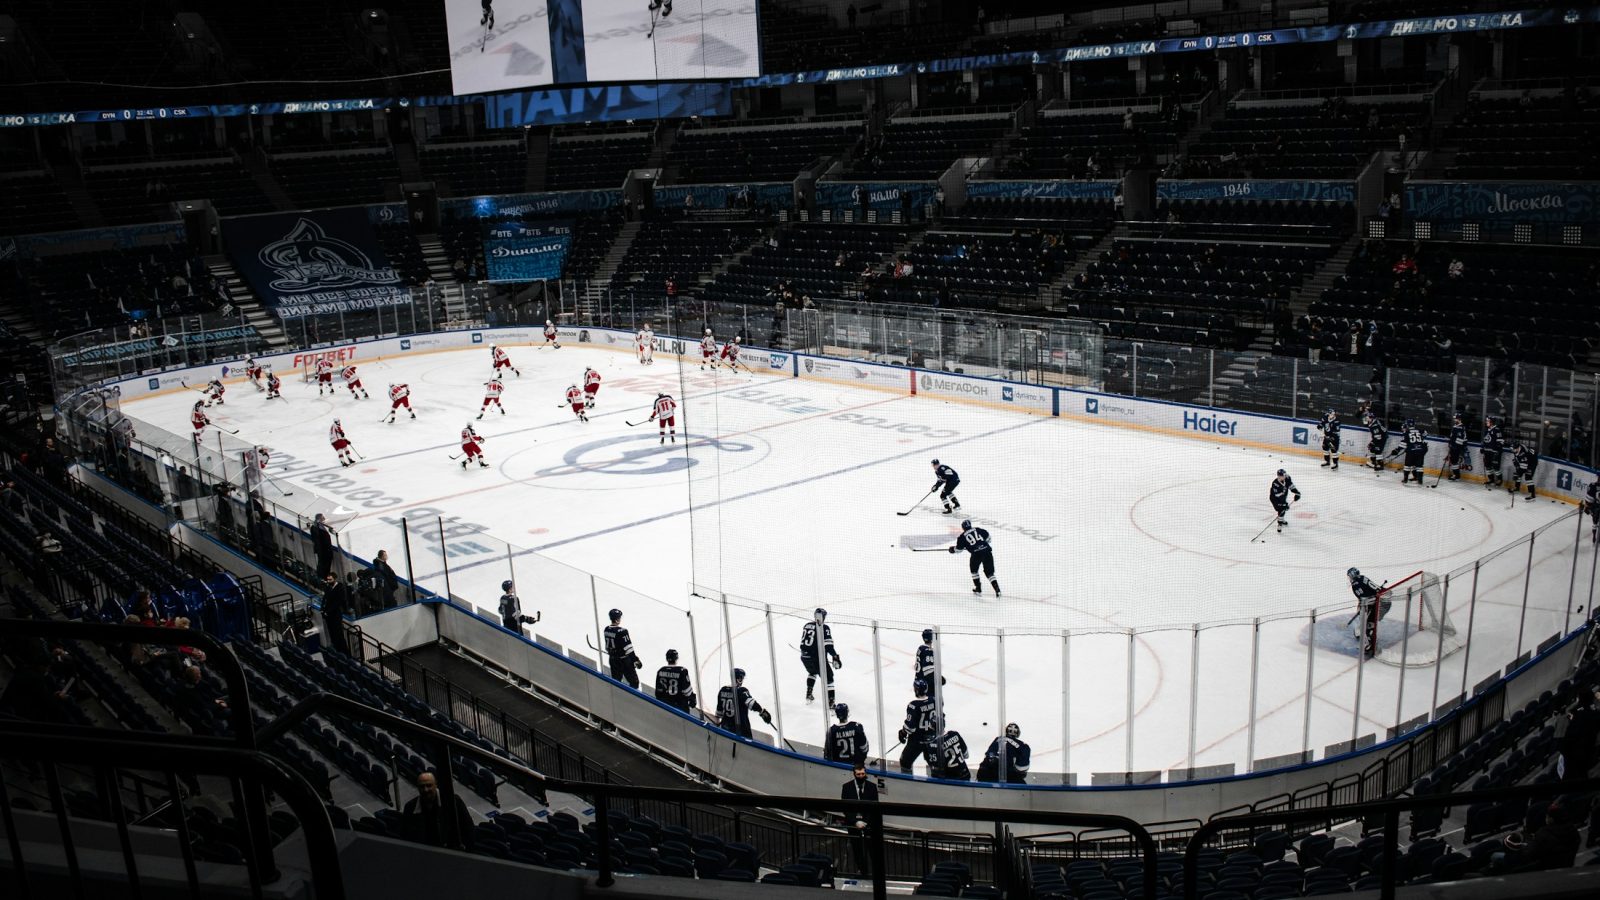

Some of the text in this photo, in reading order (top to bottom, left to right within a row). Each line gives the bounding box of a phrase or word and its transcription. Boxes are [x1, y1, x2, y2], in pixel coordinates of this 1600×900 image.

[1205, 36, 1213, 48] 0
[1242, 33, 1250, 46] 0
[123, 109, 132, 120] 0
[159, 108, 167, 119] 0
[1223, 183, 1251, 197] 1946
[1487, 191, 1563, 214] Москва
[497, 230, 513, 238] ВТБ
[526, 229, 542, 237] ВТБ
[555, 227, 570, 235] ВТБ
[492, 244, 562, 257] Динамо
[337, 266, 392, 280] МОСКВА
[657, 341, 686, 355] HL.RU
[771, 355, 786, 367] SAP
[661, 402, 670, 411] 11
[1183, 410, 1237, 436] Haier
[1408, 432, 1422, 443] 55
[965, 530, 984, 546] 94
[837, 738, 854, 758] 21
[944, 742, 965, 768] 25
